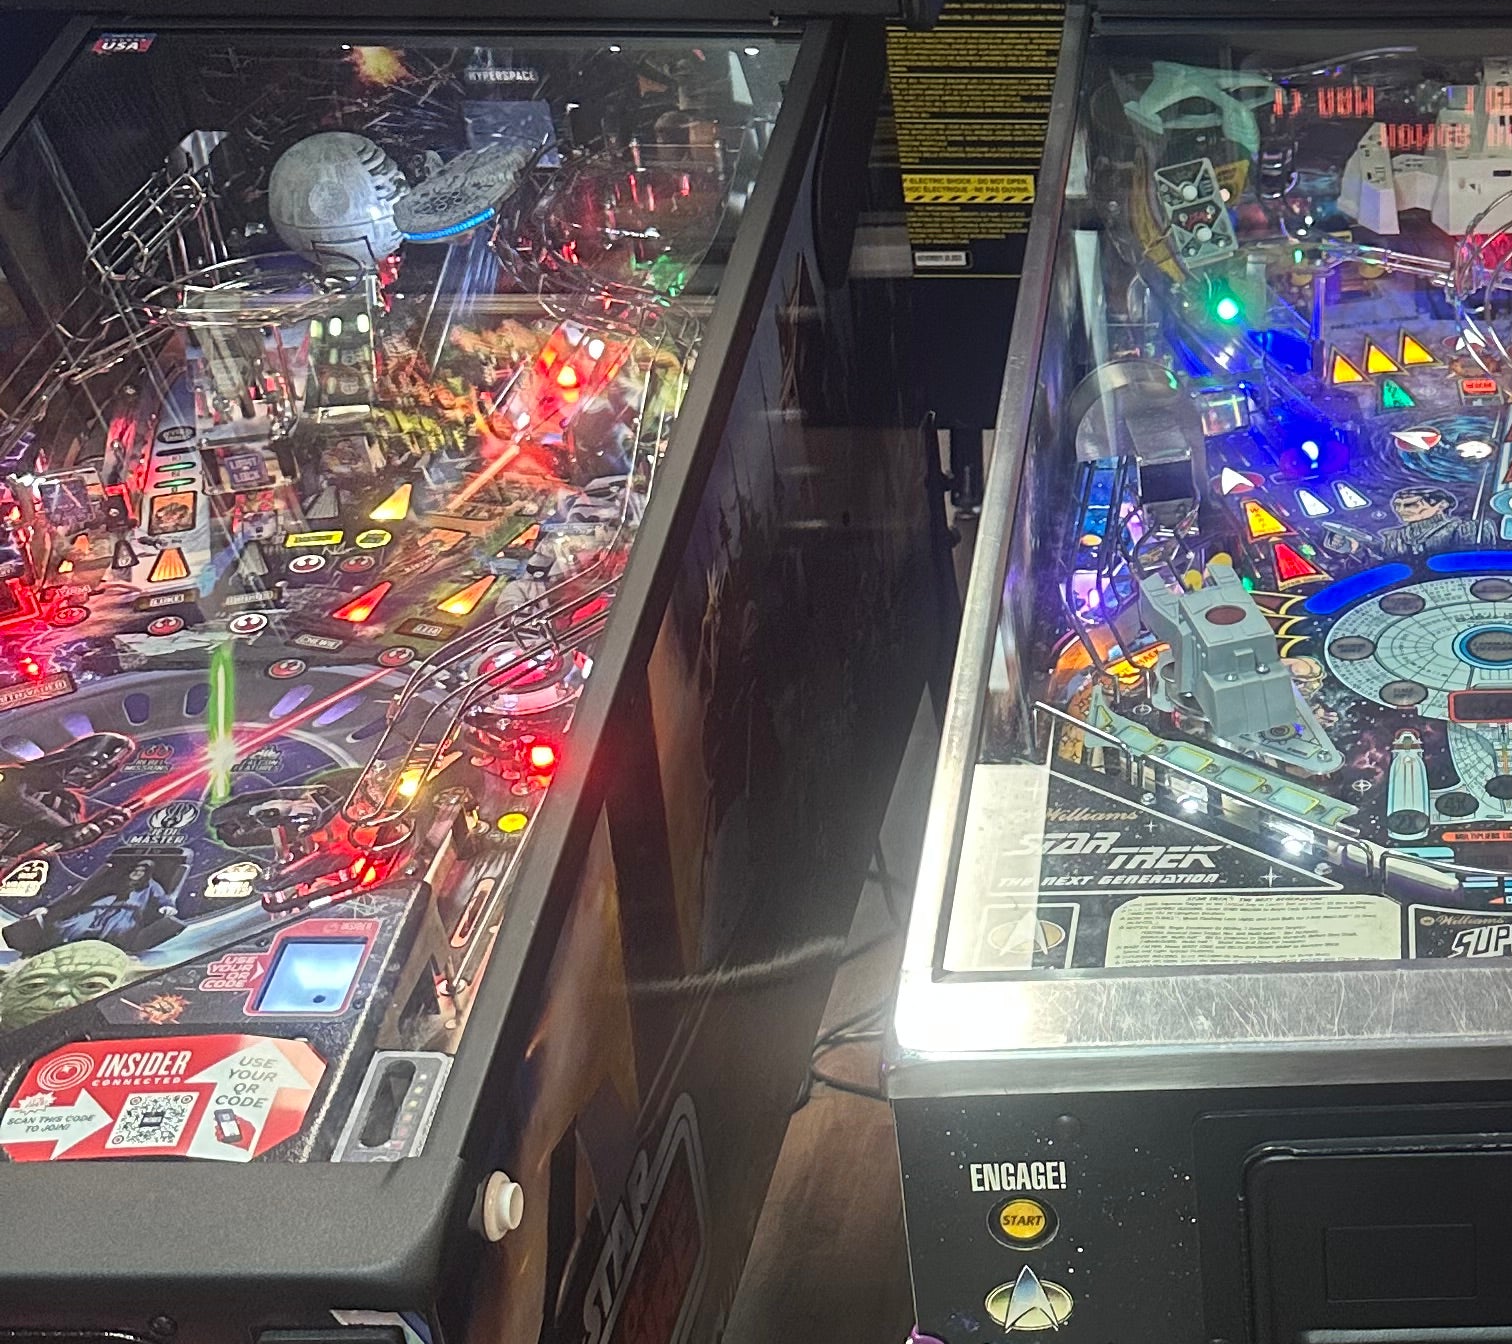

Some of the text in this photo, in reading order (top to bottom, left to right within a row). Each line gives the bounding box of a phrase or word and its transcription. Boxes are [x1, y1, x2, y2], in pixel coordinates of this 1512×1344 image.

[101, 41, 140, 51] USA
[468, 70, 536, 81] HYPERSPACE
[1047, 807, 1139, 822] Williams
[129, 835, 187, 844] MASTER
[1000, 831, 1121, 856] STAR
[1108, 845, 1225, 870] TREK
[1041, 875, 1095, 886] NEXT
[1098, 873, 1220, 885] GENERATION
[223, 956, 256, 965] USE
[210, 964, 254, 973] YOUR
[226, 972, 250, 980] QR
[204, 979, 248, 988] CODE
[96, 1051, 192, 1078] INSIDER
[239, 1056, 279, 1069] USE
[91, 1076, 182, 1087] CONNECTED
[228, 1069, 279, 1082] YOUR
[232, 1082, 260, 1095] QR
[215, 1095, 269, 1109] CODE
[7, 1113, 97, 1126] SCAN THIS CODE
[26, 1125, 40, 1133] TO
[970, 1161, 1067, 1192] ENGAGE!
[1002, 1215, 1042, 1227] START
